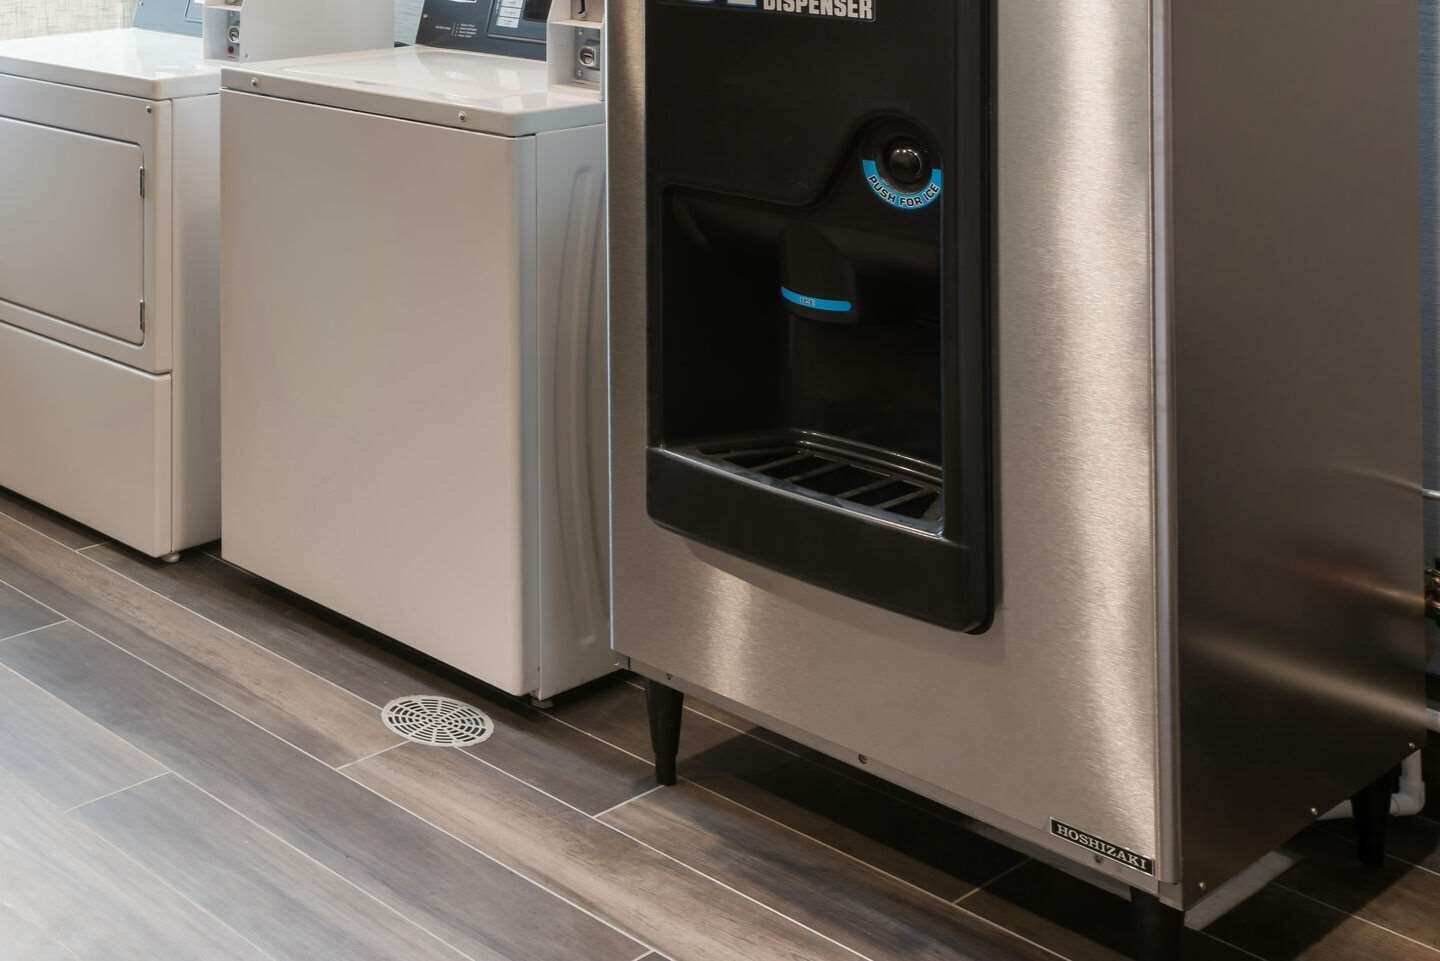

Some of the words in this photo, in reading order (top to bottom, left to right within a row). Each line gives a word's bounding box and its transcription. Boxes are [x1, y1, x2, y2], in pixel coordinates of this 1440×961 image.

[868, 175, 897, 203] PUSH
[900, 196, 923, 207] FOR
[924, 183, 940, 201] ICE
[1056, 823, 1147, 870] HOSHIZAKI
